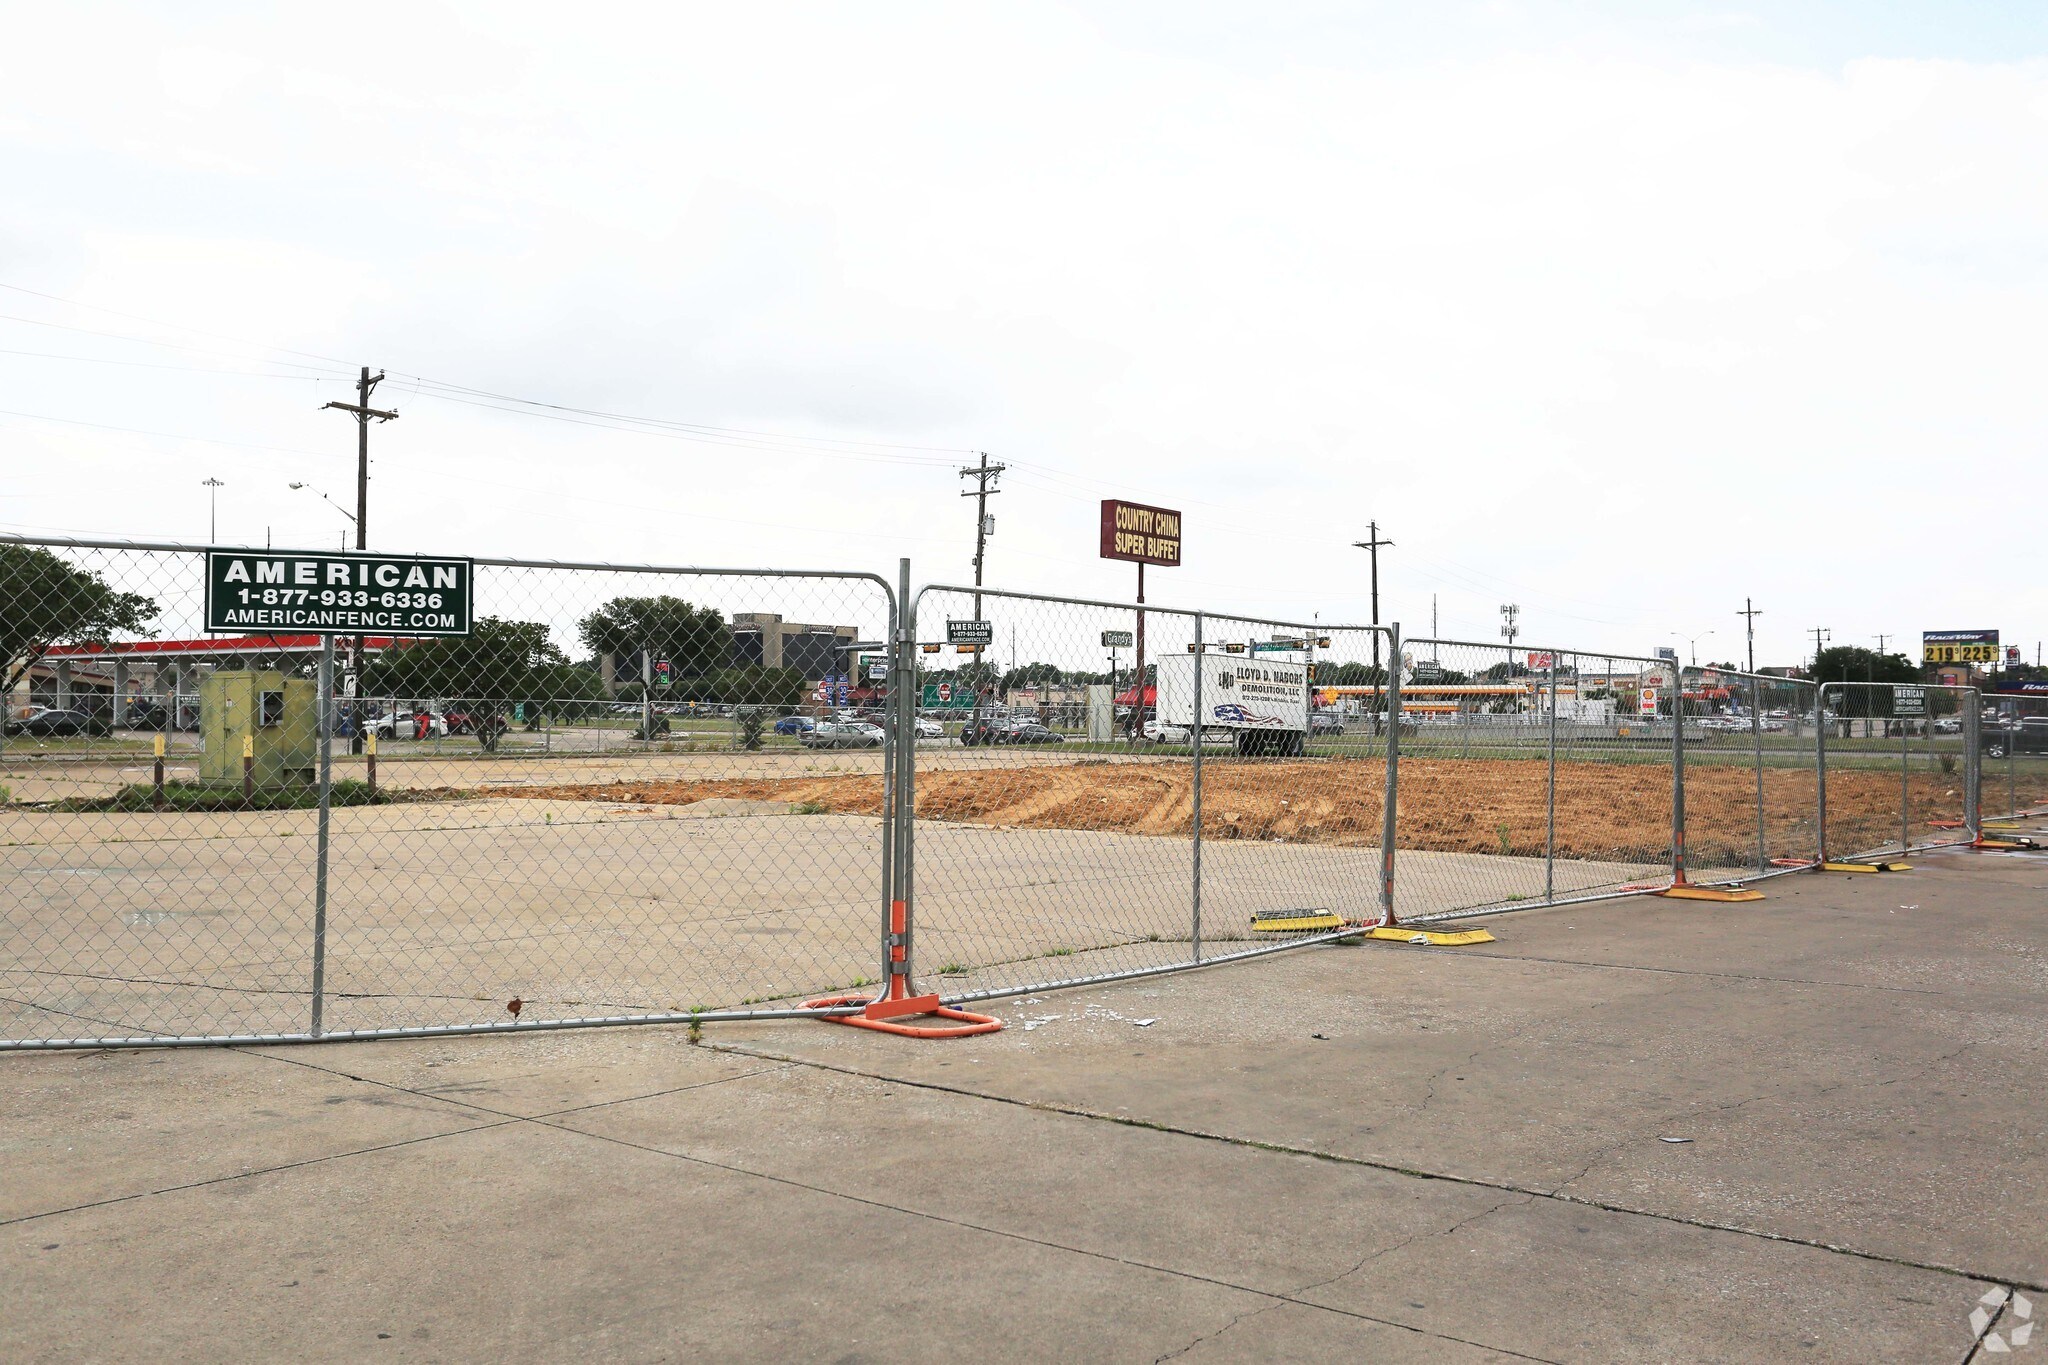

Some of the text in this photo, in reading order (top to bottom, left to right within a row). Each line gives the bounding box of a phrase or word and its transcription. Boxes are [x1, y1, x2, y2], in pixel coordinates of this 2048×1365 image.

[1115, 505, 1179, 537] COUNTRY CHINA
[1115, 532, 1179, 560] SUPER BUFFET
[223, 560, 457, 589] AMERICAN
[238, 588, 443, 609] 1-877-933-6336
[224, 609, 455, 628] AMERICANFENCE.COM
[1236, 667, 1303, 685] LLOYD D. NABORS
[1241, 684, 1300, 696] DEMOLITION, LLC
[1895, 689, 1924, 698] AMERICAN
